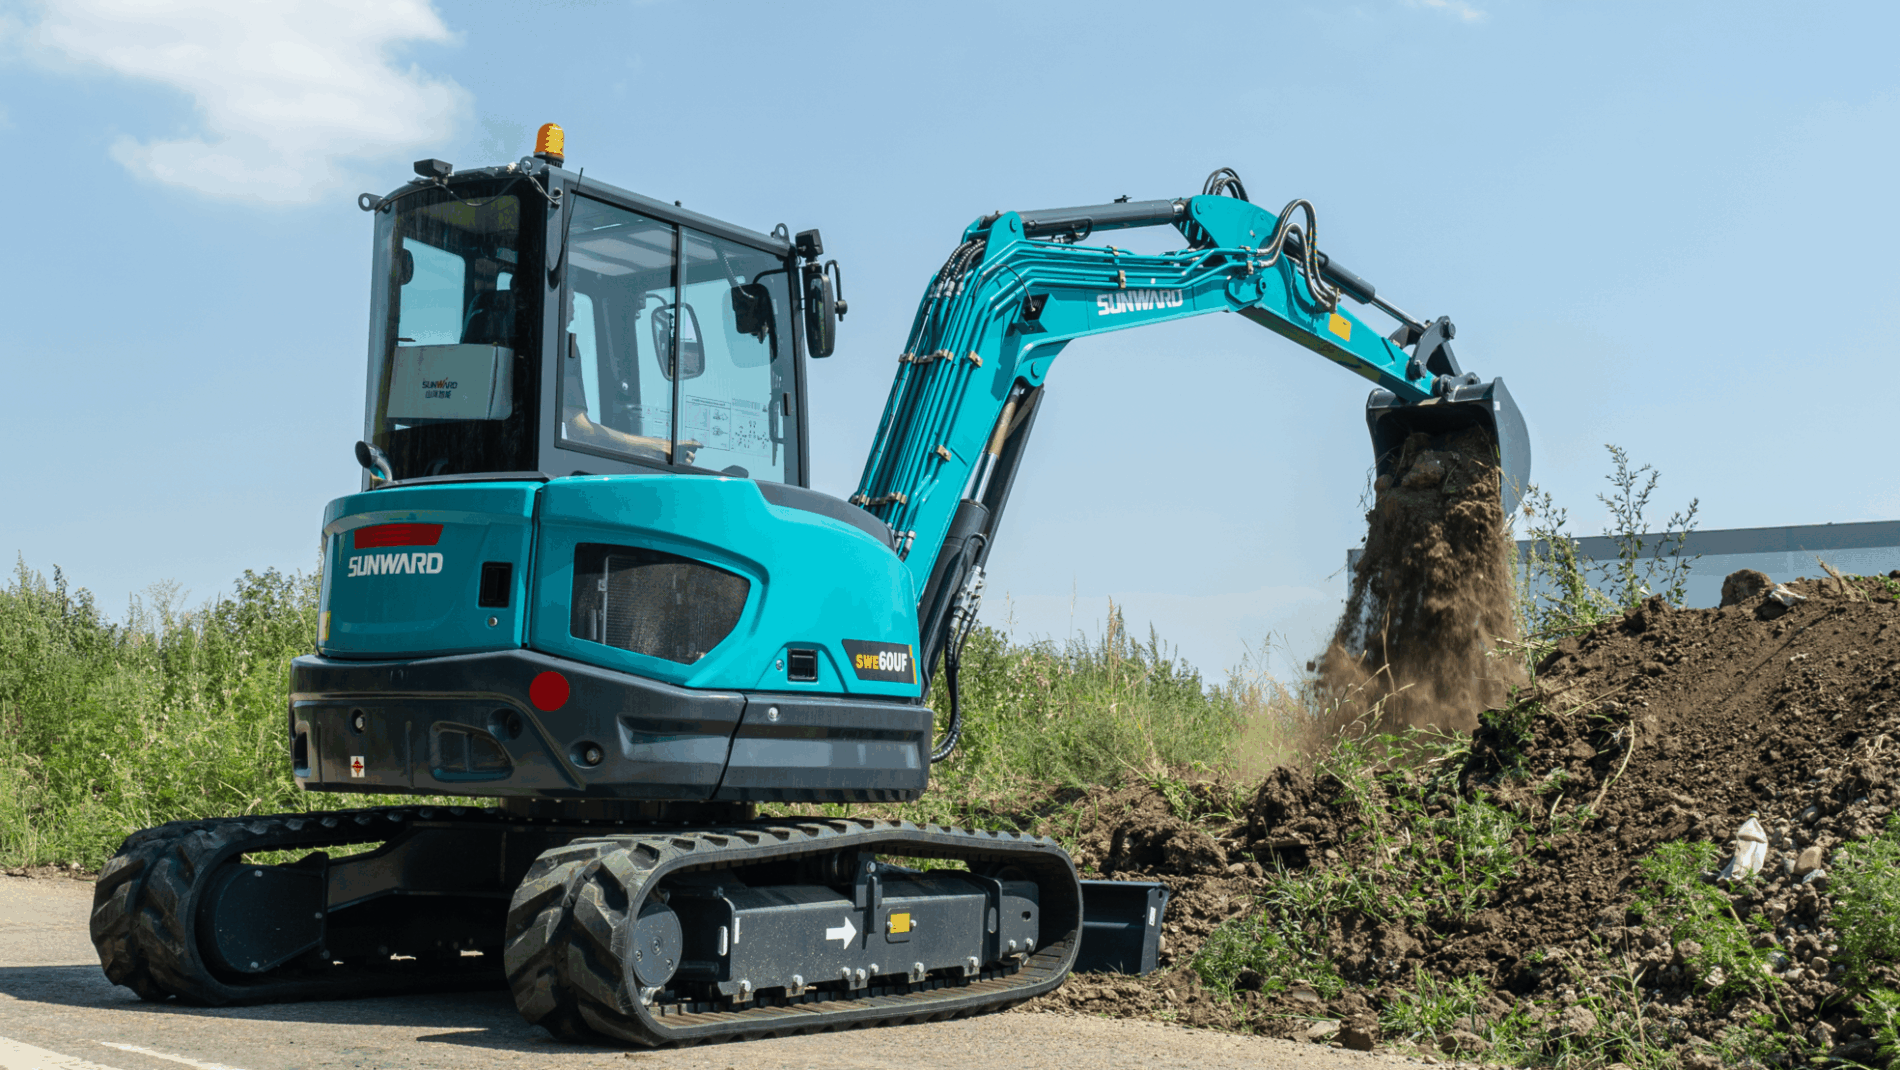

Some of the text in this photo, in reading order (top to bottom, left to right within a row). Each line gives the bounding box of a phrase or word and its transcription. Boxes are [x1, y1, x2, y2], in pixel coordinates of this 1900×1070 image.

[1096, 289, 1183, 316] SUNWARD
[421, 377, 458, 389] SUNWARD
[347, 552, 443, 577] SUNWARD
[855, 651, 907, 672] SWE60UF
